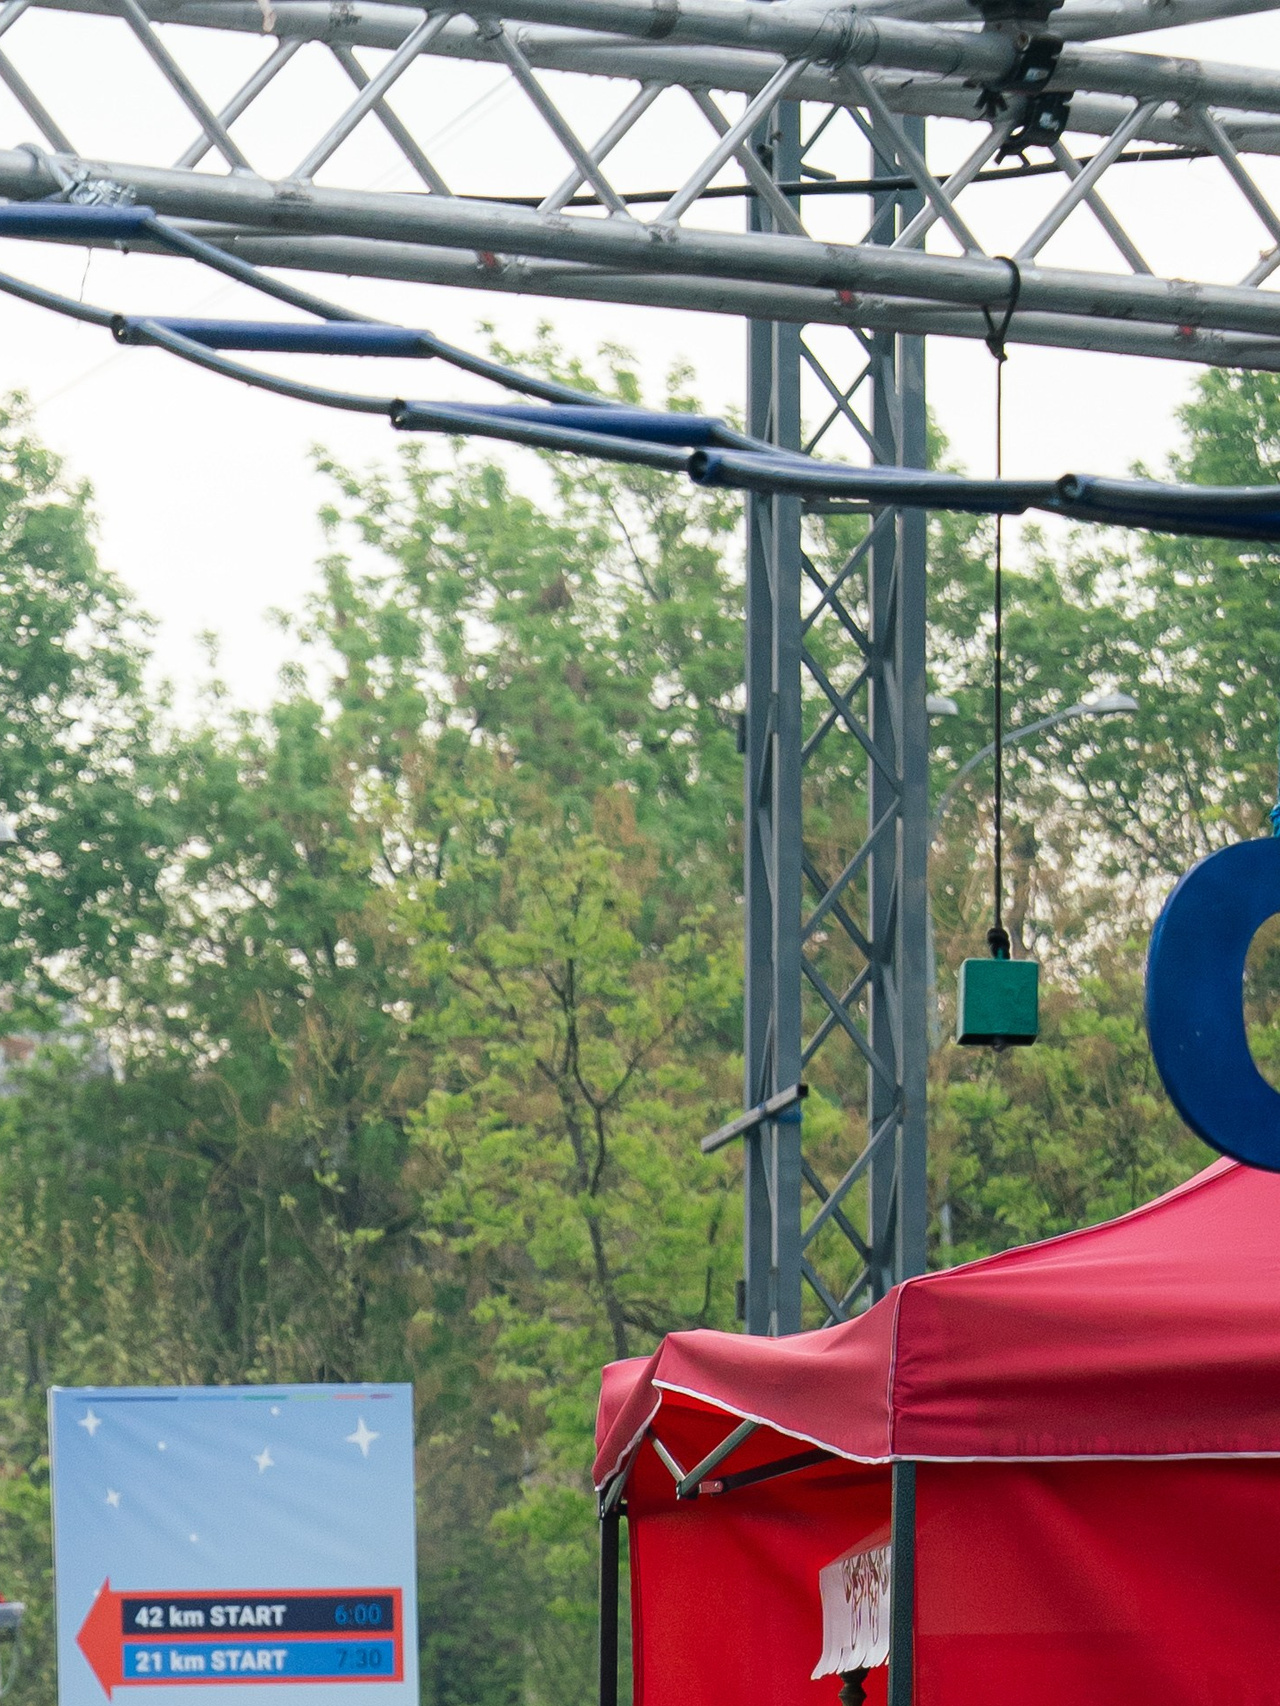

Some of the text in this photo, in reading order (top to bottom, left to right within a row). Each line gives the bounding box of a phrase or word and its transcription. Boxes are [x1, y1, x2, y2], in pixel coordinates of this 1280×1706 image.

[135, 1602, 382, 1628] 42 km START 6:00
[135, 1647, 382, 1672] 21 km START 7:30
